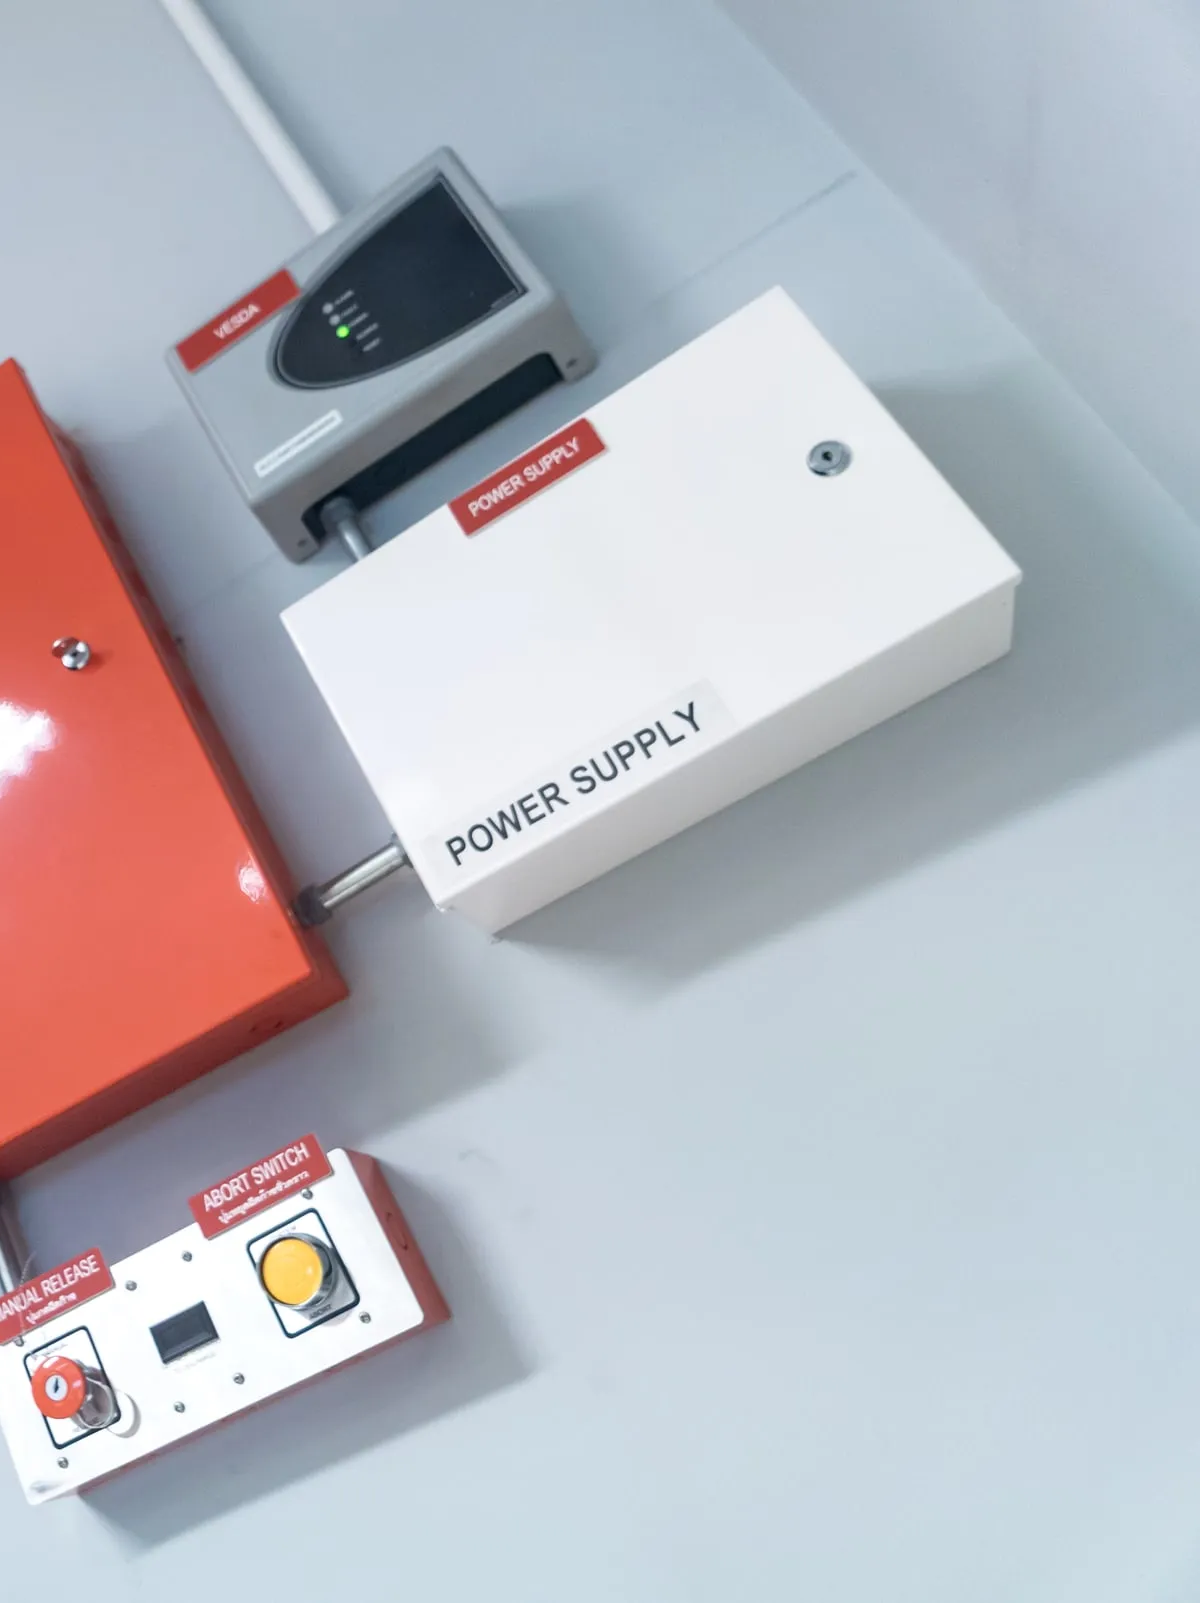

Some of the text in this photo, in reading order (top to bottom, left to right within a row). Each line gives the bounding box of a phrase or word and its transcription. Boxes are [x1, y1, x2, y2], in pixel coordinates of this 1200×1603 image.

[212, 303, 260, 339] VESDA
[467, 436, 581, 517] POWER SUPPLY
[445, 701, 701, 866] POWER SUPPLY
[203, 1142, 311, 1213] ABORT SWITCH
[40, 1254, 101, 1298] RELEASE
